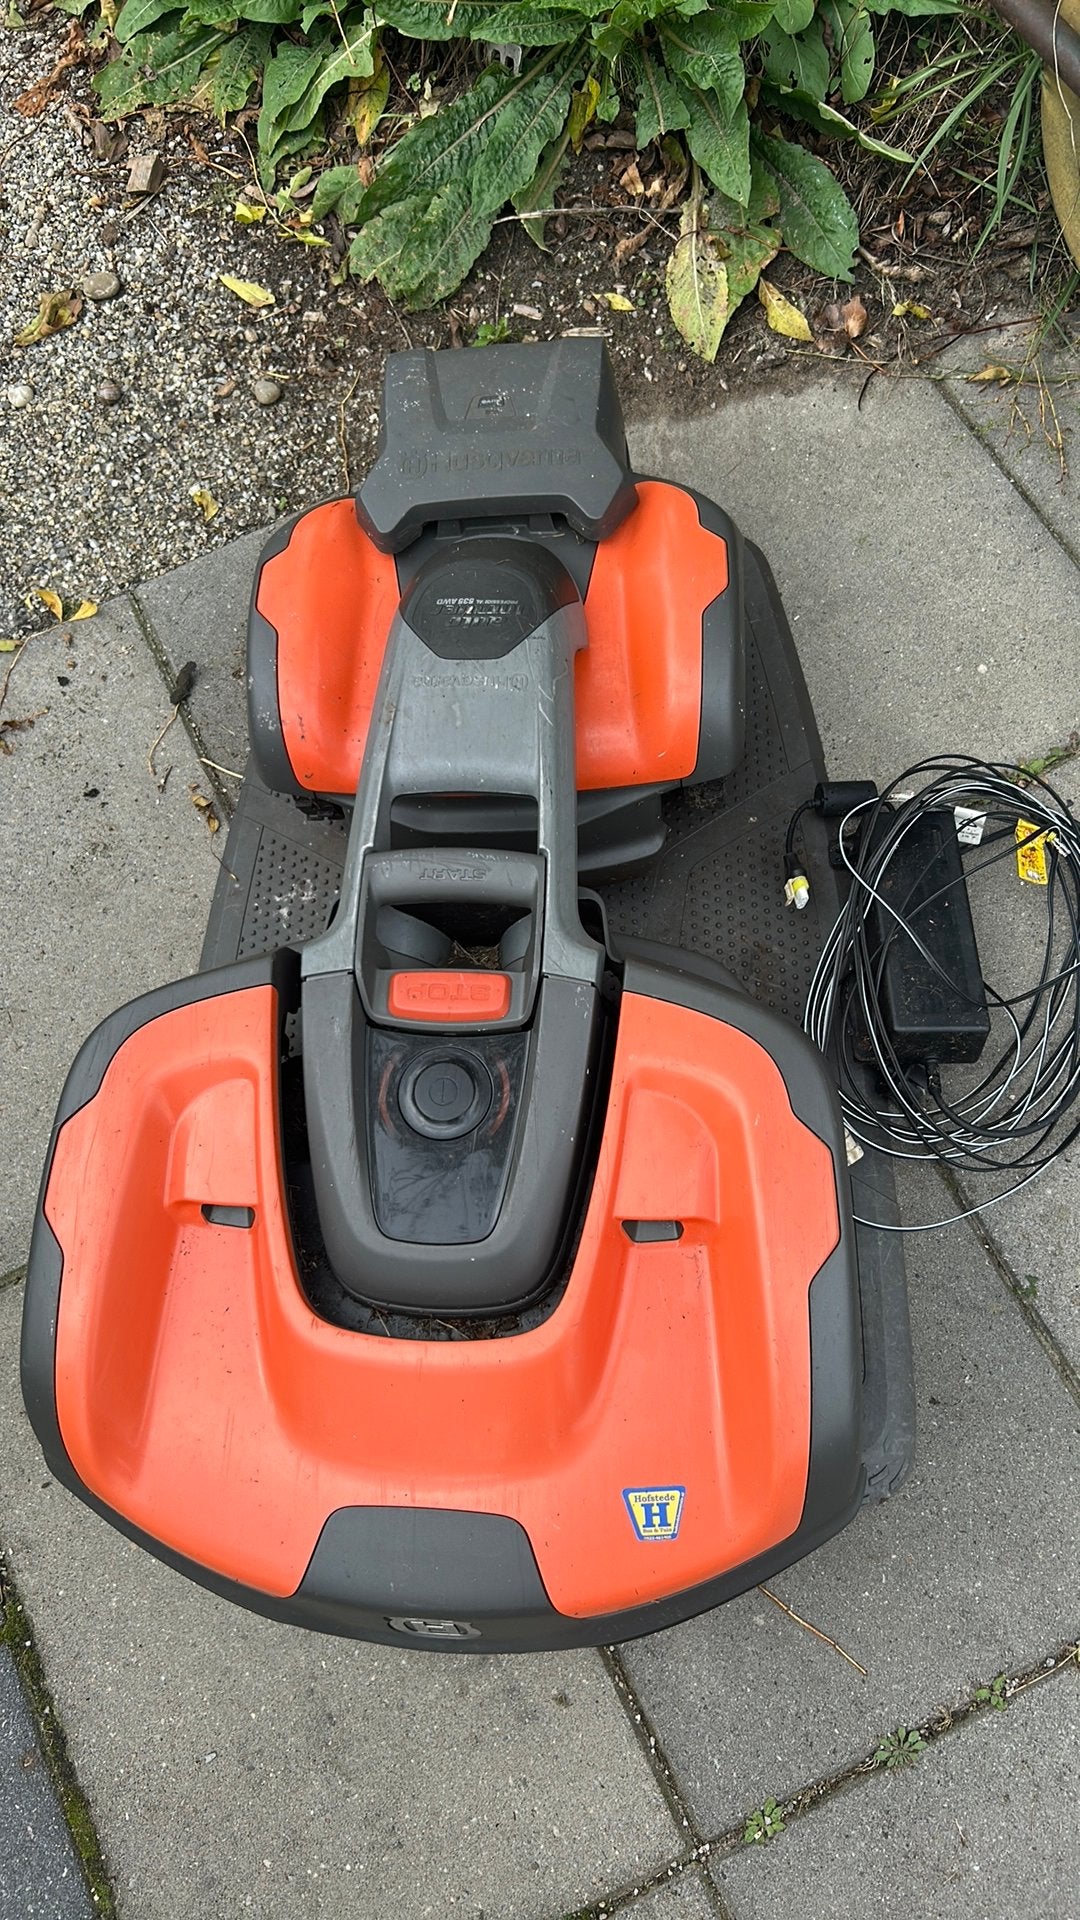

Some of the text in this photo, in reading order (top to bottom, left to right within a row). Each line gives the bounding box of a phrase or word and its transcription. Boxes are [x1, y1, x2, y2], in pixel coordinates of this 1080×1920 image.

[419, 868, 487, 881] START
[407, 983, 492, 1002] STOP
[634, 1494, 675, 1503] Hofstede
[641, 1502, 671, 1528] H
